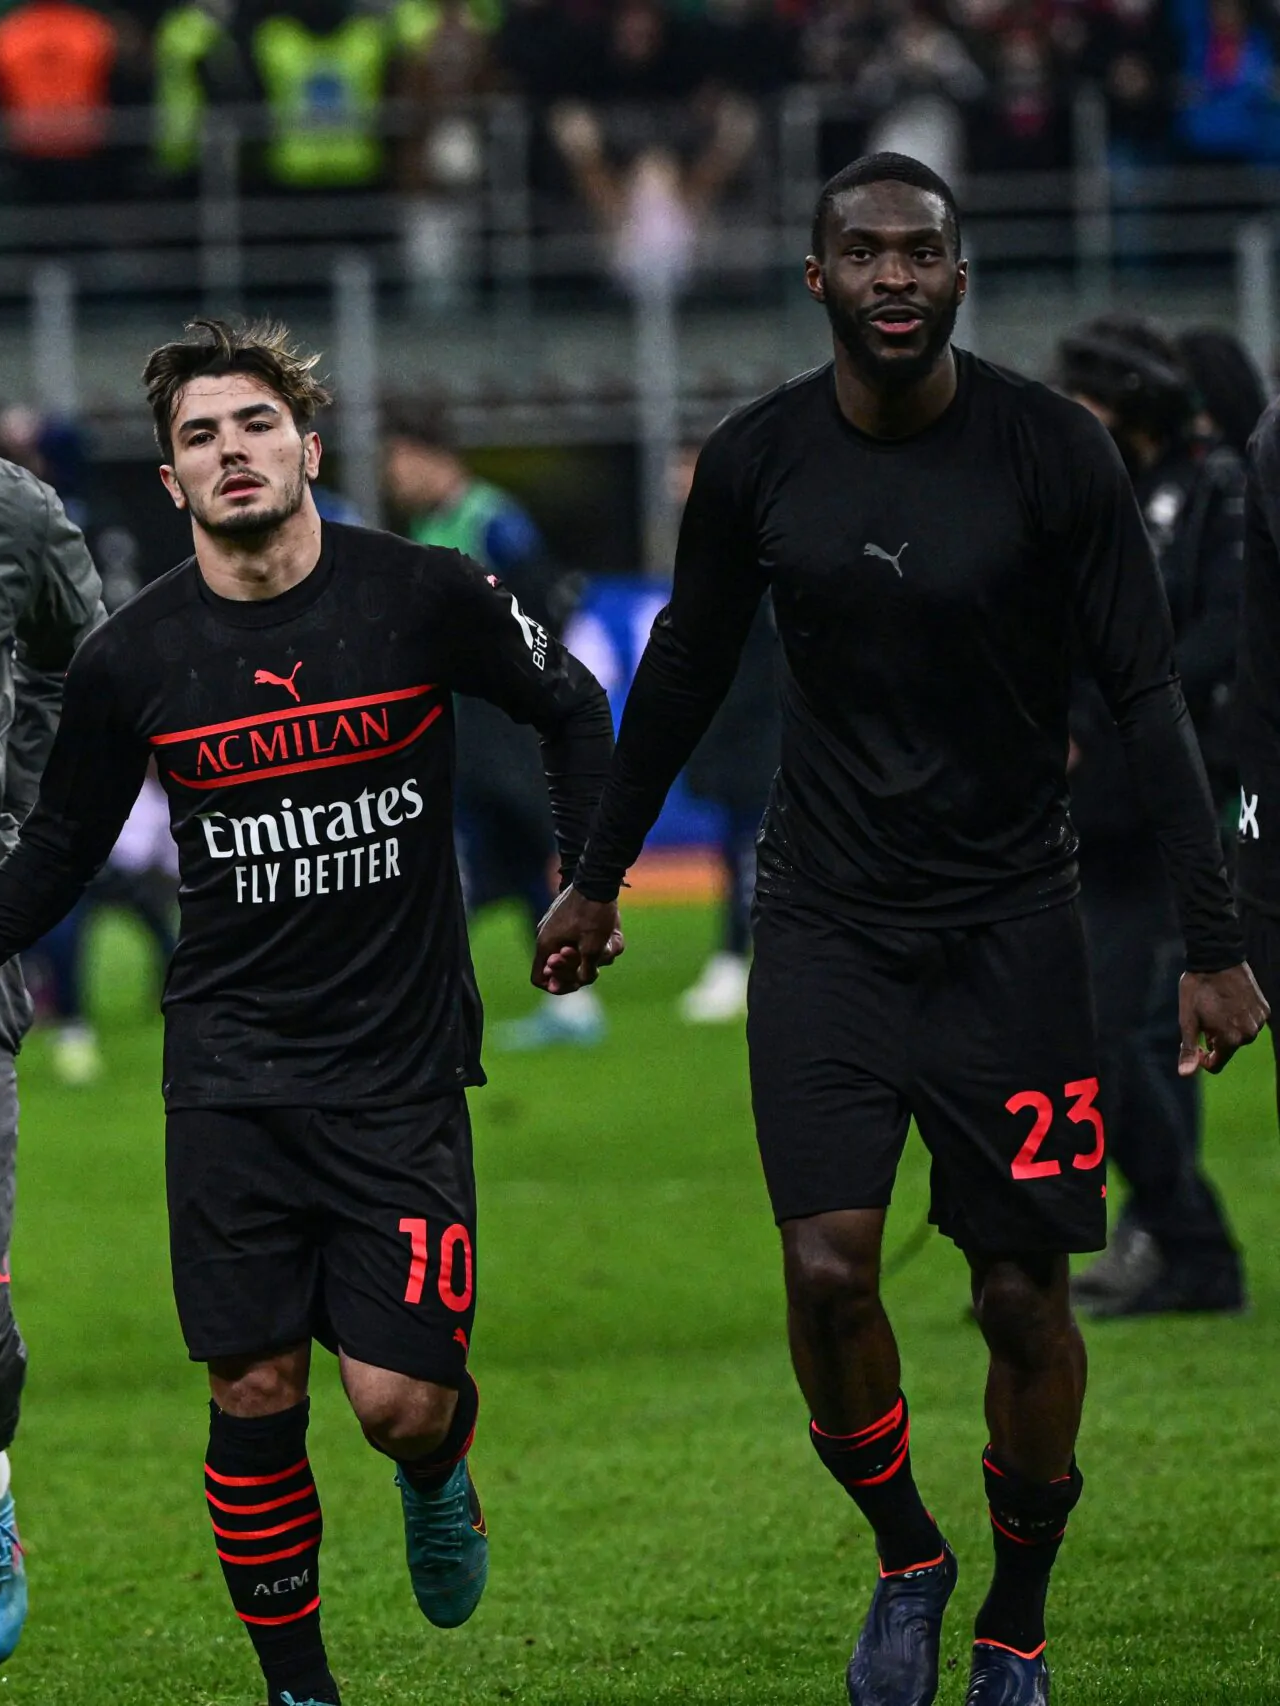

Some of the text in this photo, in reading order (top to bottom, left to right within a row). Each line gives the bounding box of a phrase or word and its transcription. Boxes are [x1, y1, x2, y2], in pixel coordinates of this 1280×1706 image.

[248, 708, 389, 764] MILAN
[195, 778, 424, 859] Emirates
[235, 837, 401, 904] FLY BETTER
[1005, 1077, 1106, 1180] 23
[398, 1217, 473, 1312] 10
[253, 1568, 310, 1596] ACM
